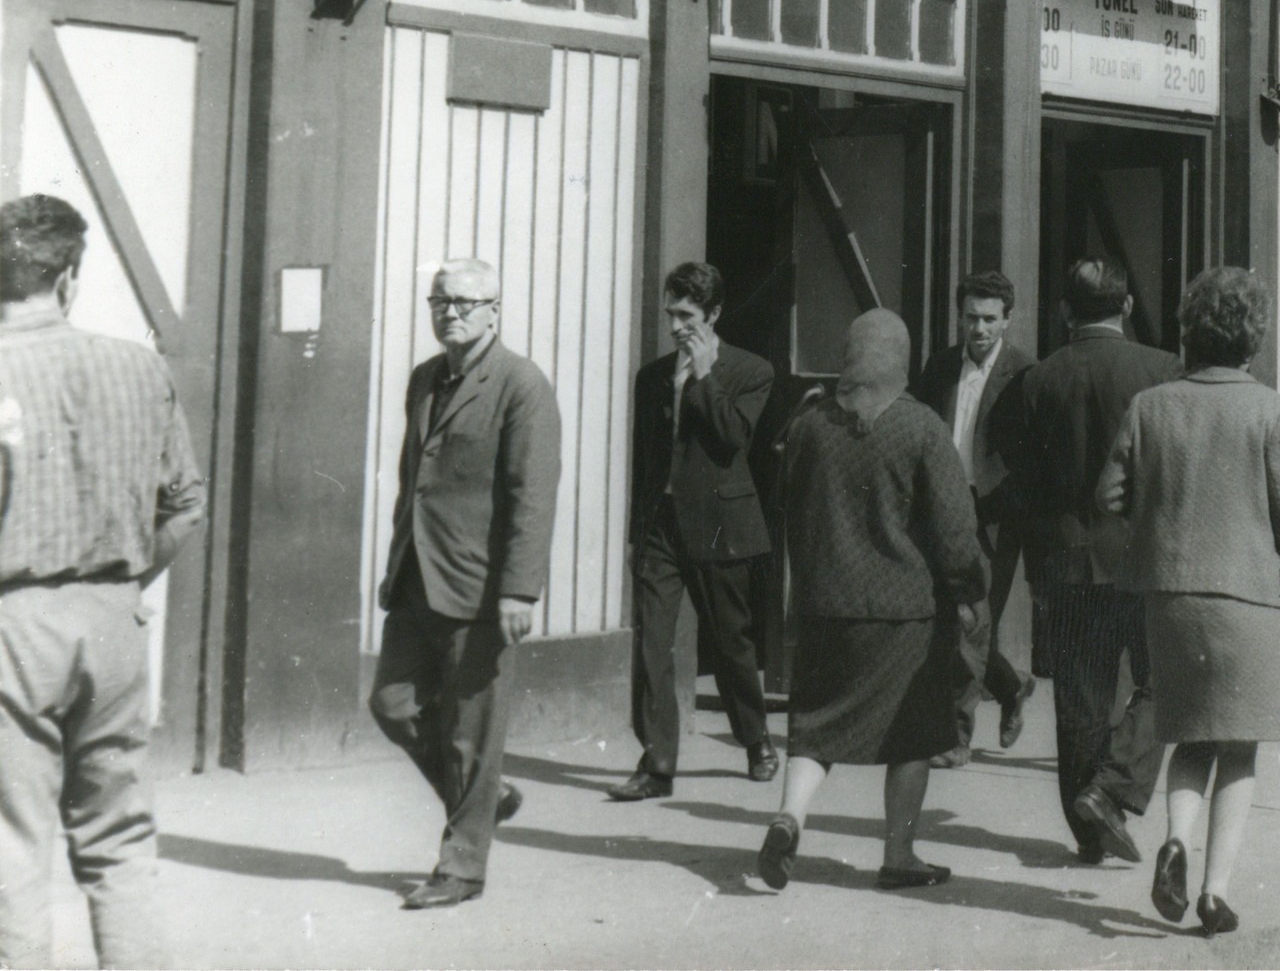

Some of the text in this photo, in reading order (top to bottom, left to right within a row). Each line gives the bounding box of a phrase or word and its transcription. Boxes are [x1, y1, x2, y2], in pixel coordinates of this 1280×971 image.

[1178, 6, 1207, 22] HAREKET
[1114, 18, 1135, 42] GÜNÜ
[1164, 30, 1206, 61] 21-00
[1090, 56, 1142, 81] PAZAR GÜNÜ
[1164, 63, 1206, 95] 22-00
